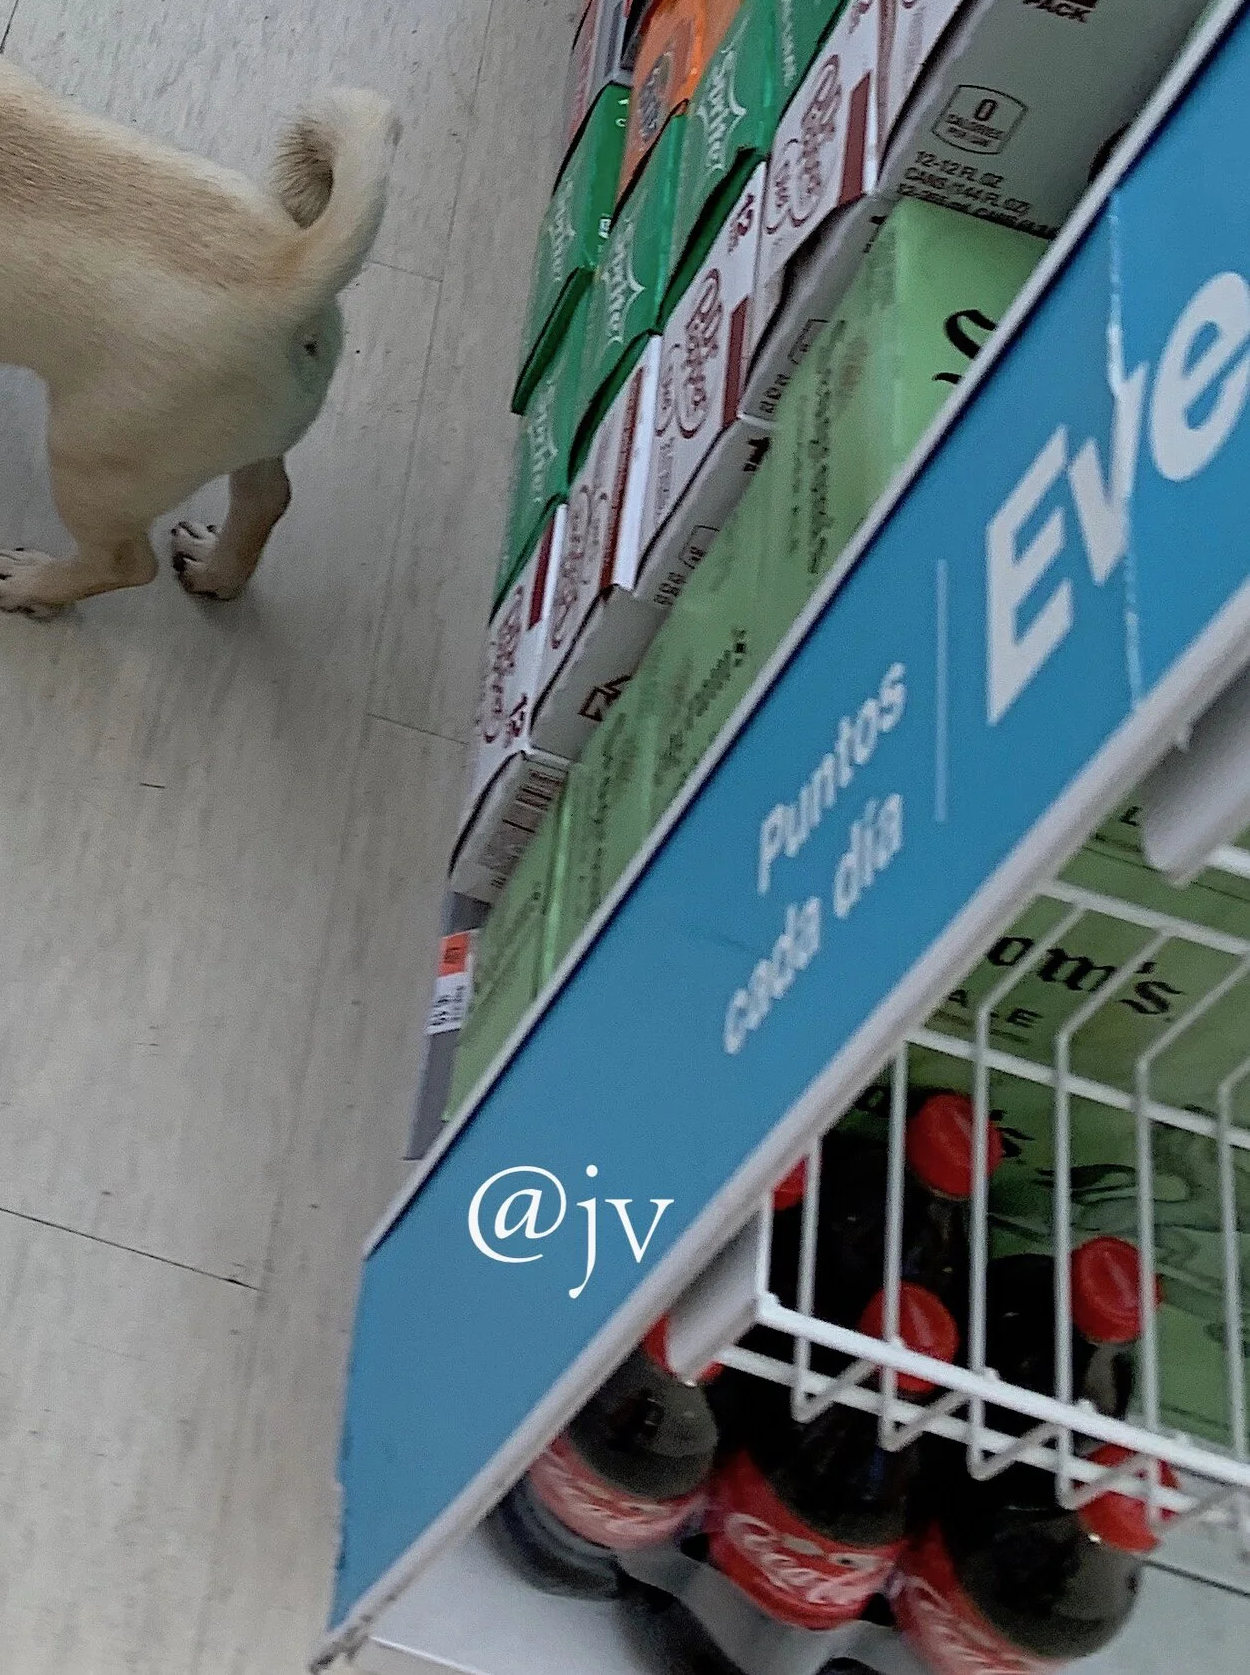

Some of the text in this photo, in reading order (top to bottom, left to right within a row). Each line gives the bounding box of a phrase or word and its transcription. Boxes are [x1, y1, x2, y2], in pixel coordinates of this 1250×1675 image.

[974, 97, 999, 122] 0
[987, 271, 1250, 726] Eve
[757, 662, 907, 895] Puntos
[723, 793, 904, 1055] cada día
